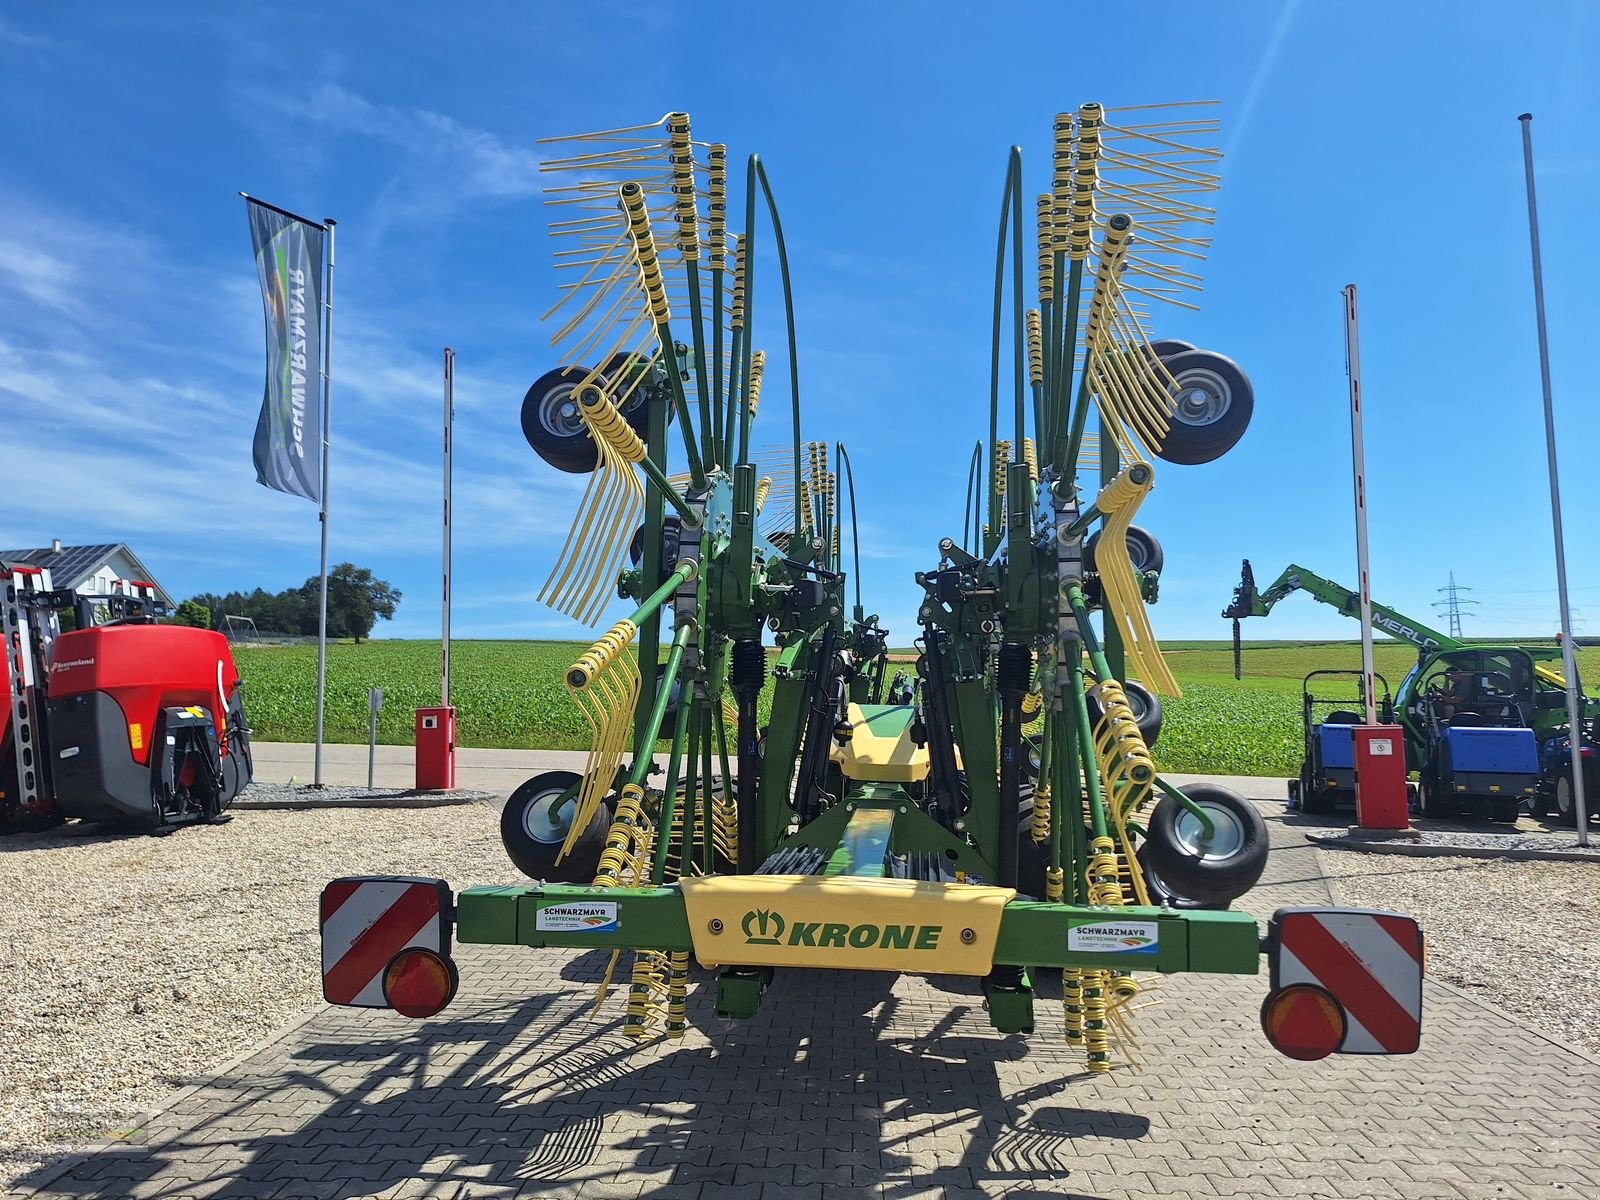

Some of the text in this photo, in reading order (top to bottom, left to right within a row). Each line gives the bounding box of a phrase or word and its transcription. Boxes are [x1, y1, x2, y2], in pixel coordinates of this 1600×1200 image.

[544, 908, 606, 916] SCHWARZMAYR
[787, 922, 943, 950] KRONE
[1076, 927, 1145, 936] SCHWARZMAYR
